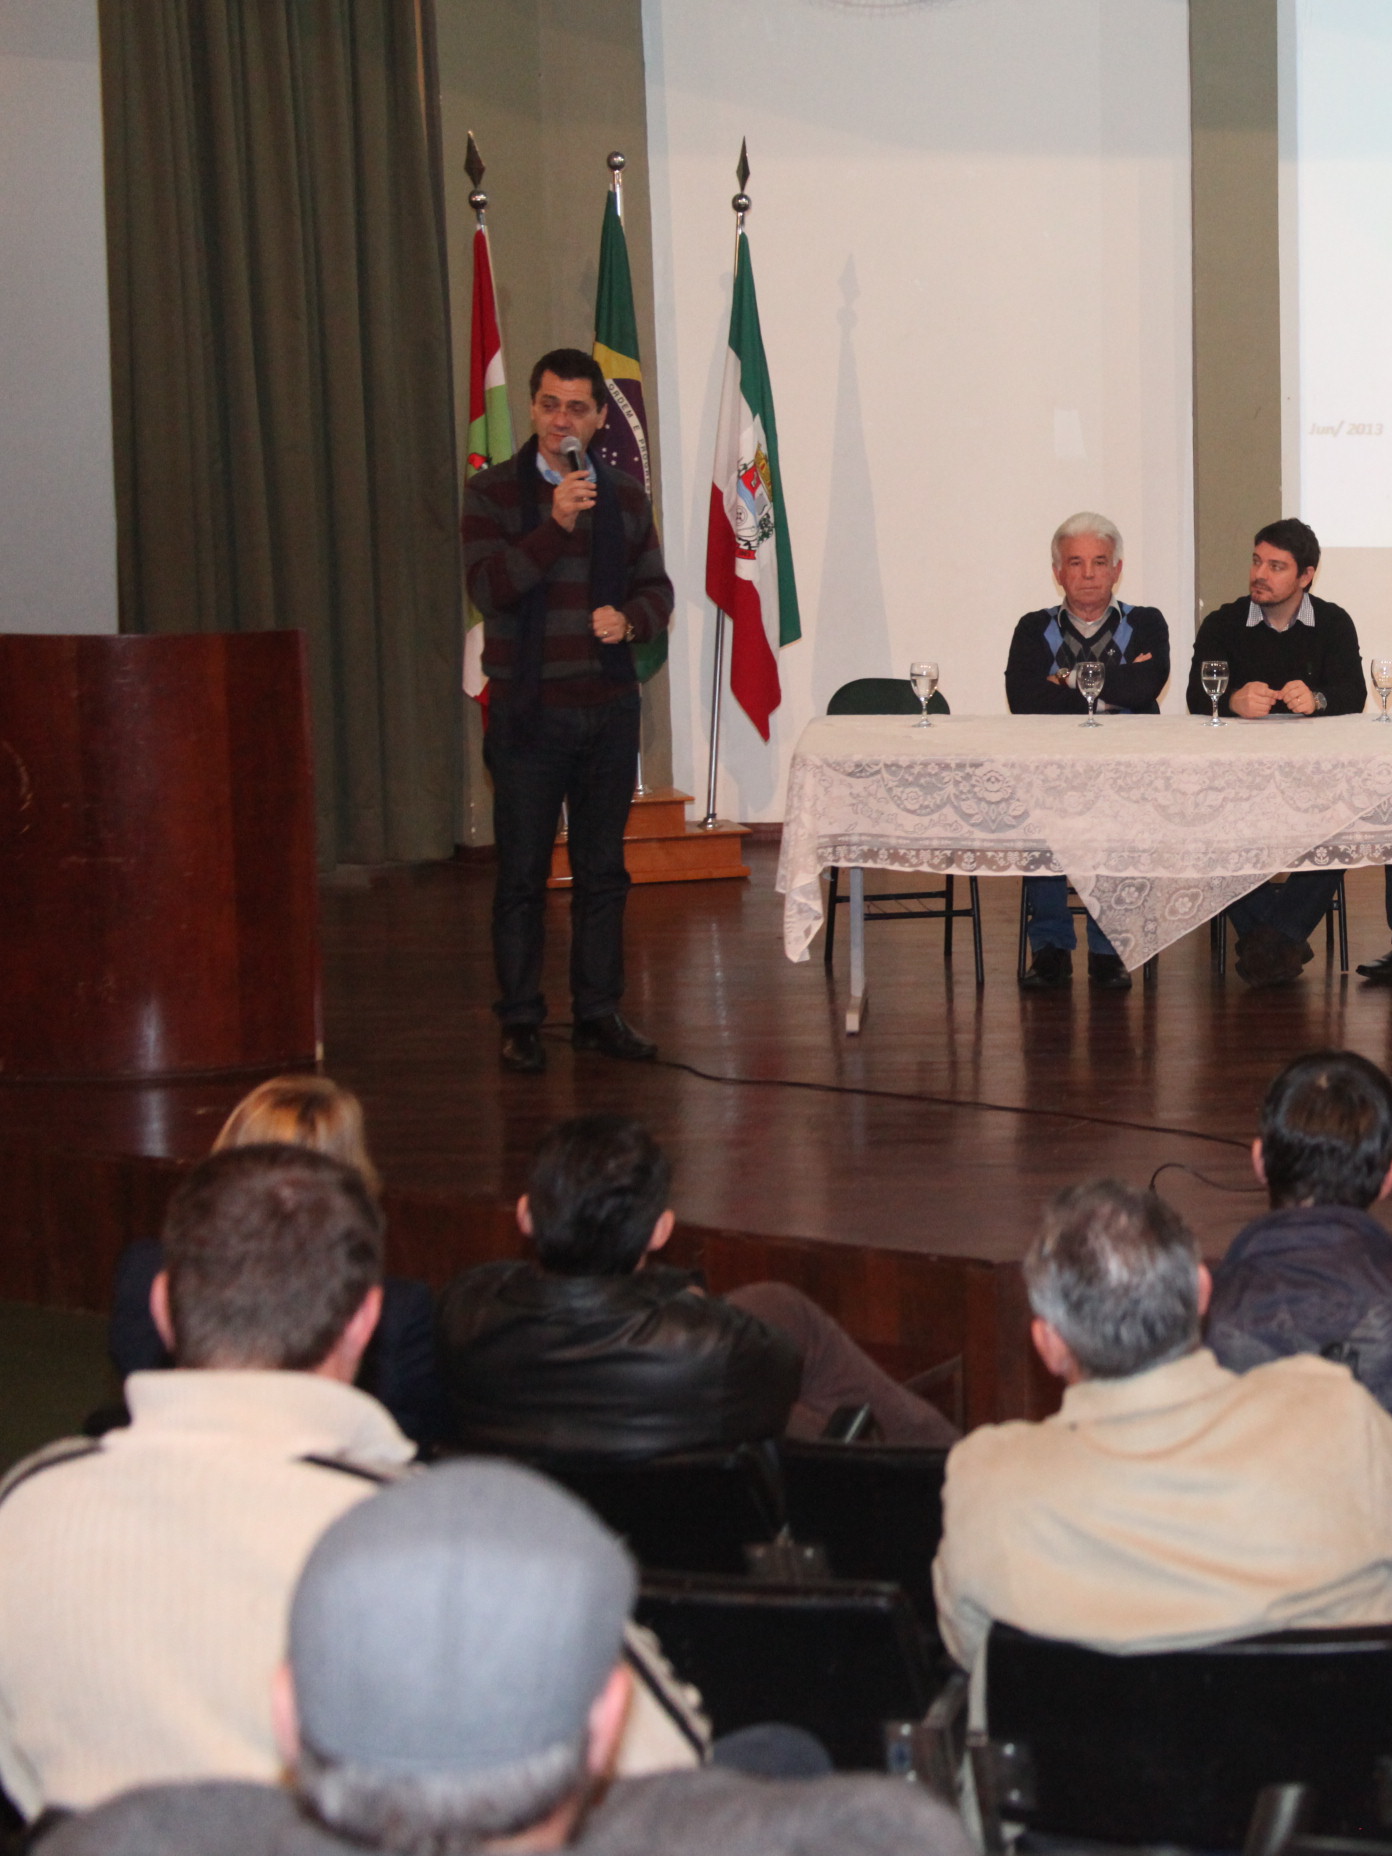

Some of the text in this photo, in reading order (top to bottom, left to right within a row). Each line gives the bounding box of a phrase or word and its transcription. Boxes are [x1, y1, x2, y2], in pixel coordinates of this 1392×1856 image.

[608, 382, 634, 418] ORDEM
[633, 423, 641, 431] E
[1346, 422, 1384, 436] 2013
